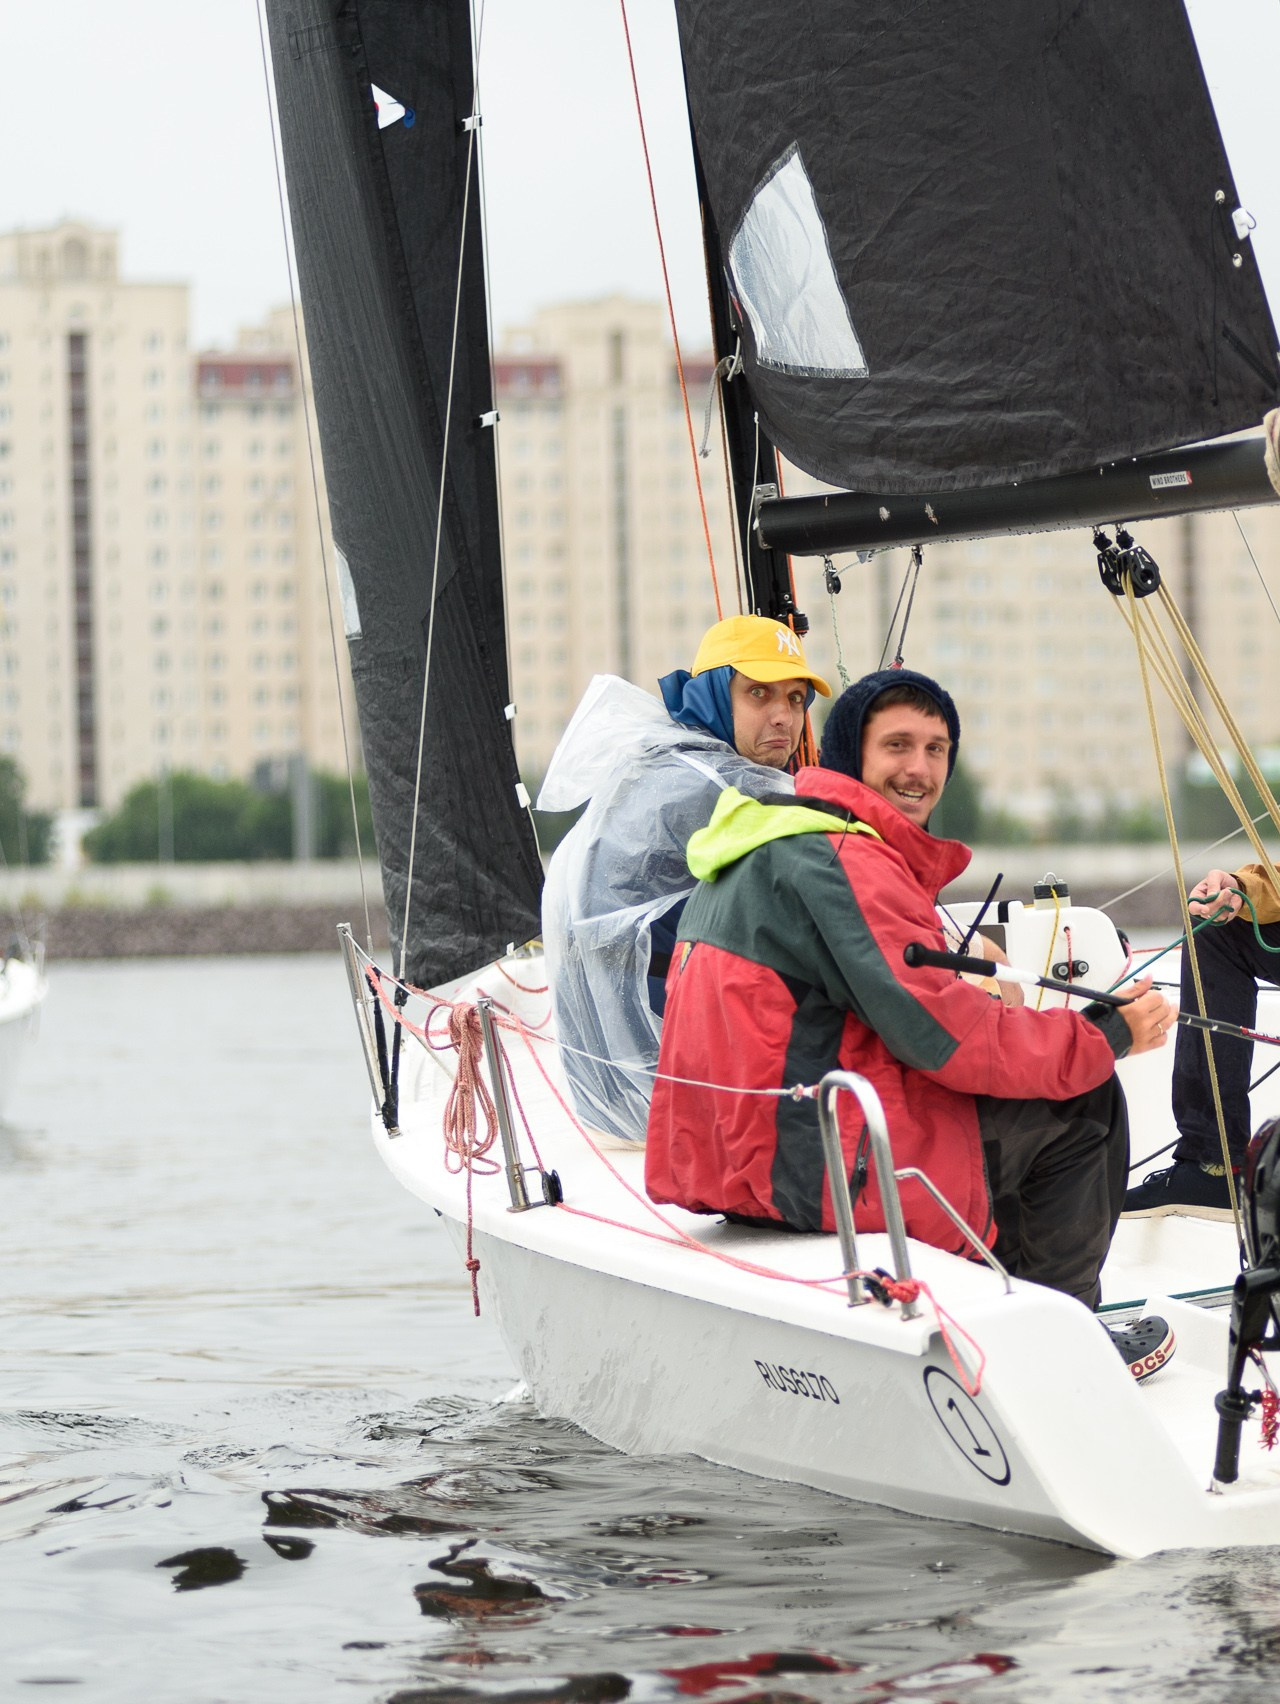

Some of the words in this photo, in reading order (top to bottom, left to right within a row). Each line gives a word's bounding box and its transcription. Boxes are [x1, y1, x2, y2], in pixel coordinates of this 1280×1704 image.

[775, 628, 801, 656] NY
[1131, 1349, 1165, 1377] OCS
[754, 1359, 840, 1405] RUS6170
[947, 1397, 991, 1457] 1
